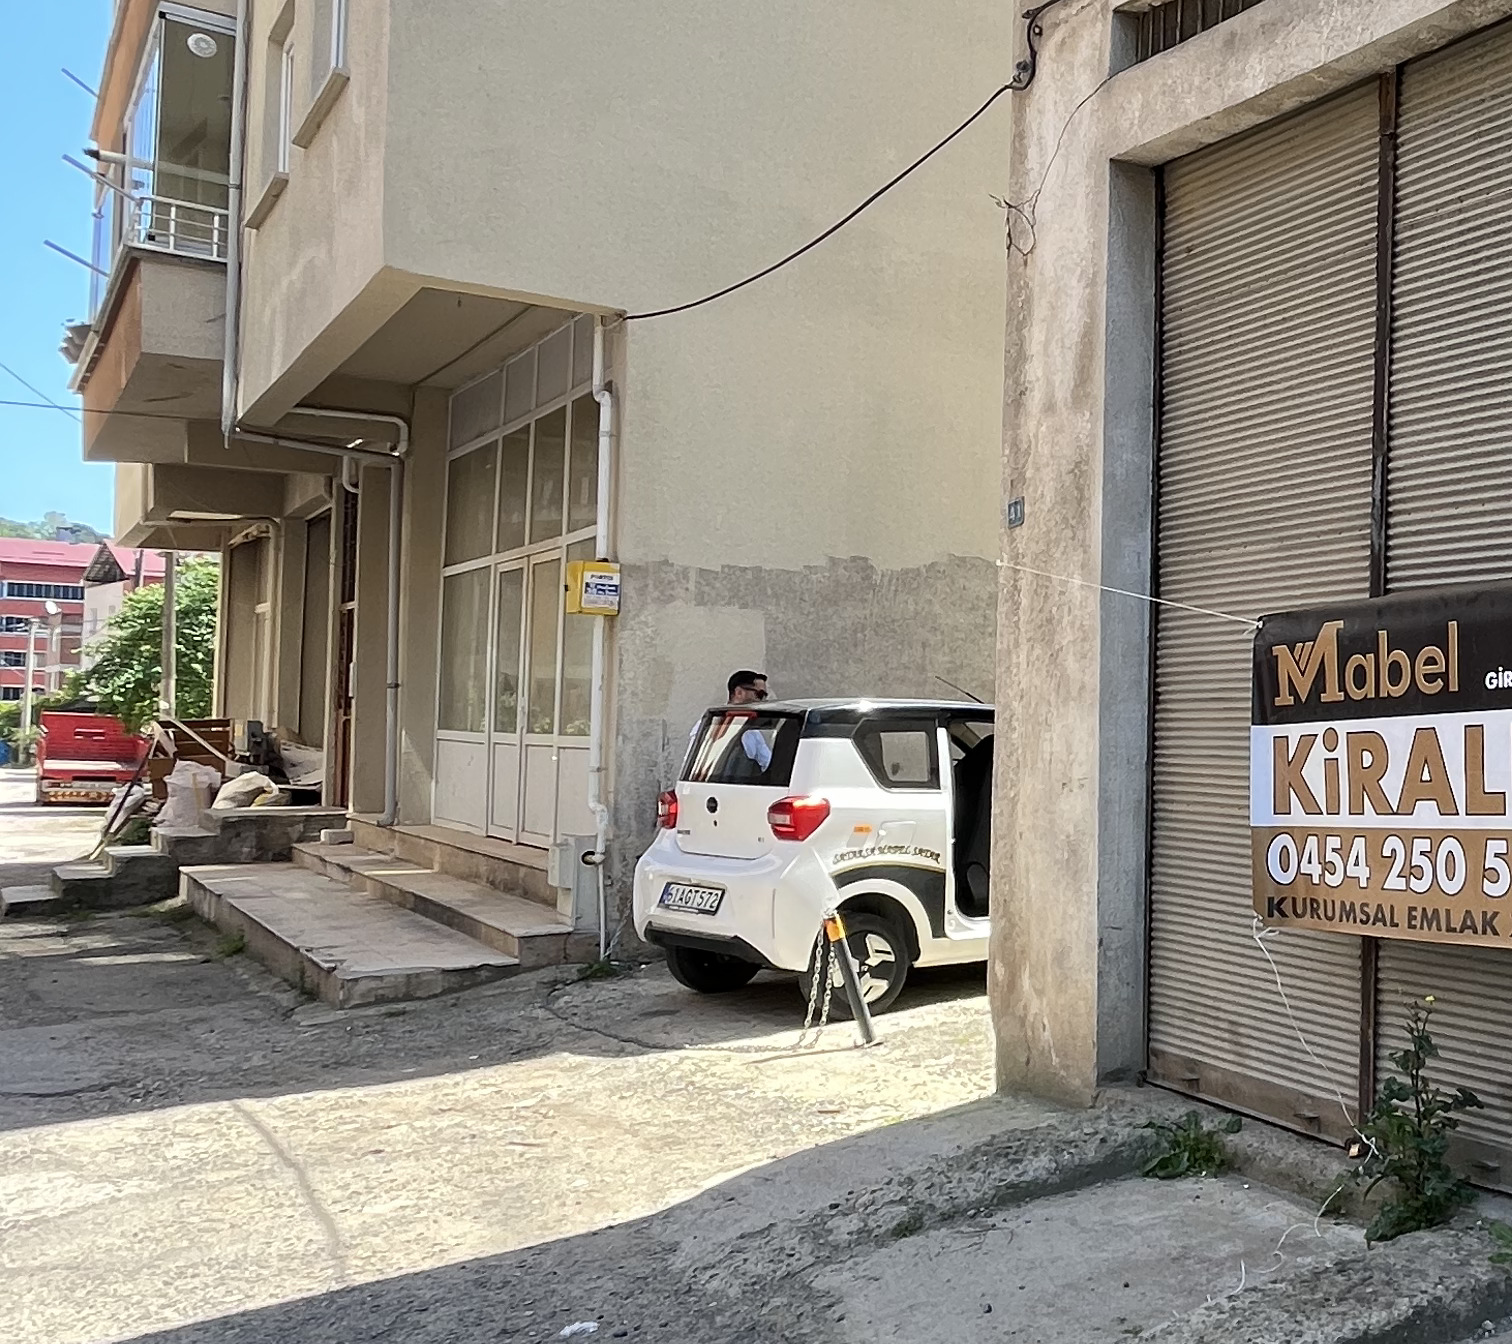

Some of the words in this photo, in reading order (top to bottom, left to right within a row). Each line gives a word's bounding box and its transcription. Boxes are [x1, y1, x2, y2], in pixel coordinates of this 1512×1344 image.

[1271, 619, 1460, 707] Mabel
[1266, 832, 1371, 888] 0454
[1381, 834, 1468, 896] 250
[1267, 895, 1400, 929] KURUMSAL
[1407, 905, 1501, 937] EMLAK
